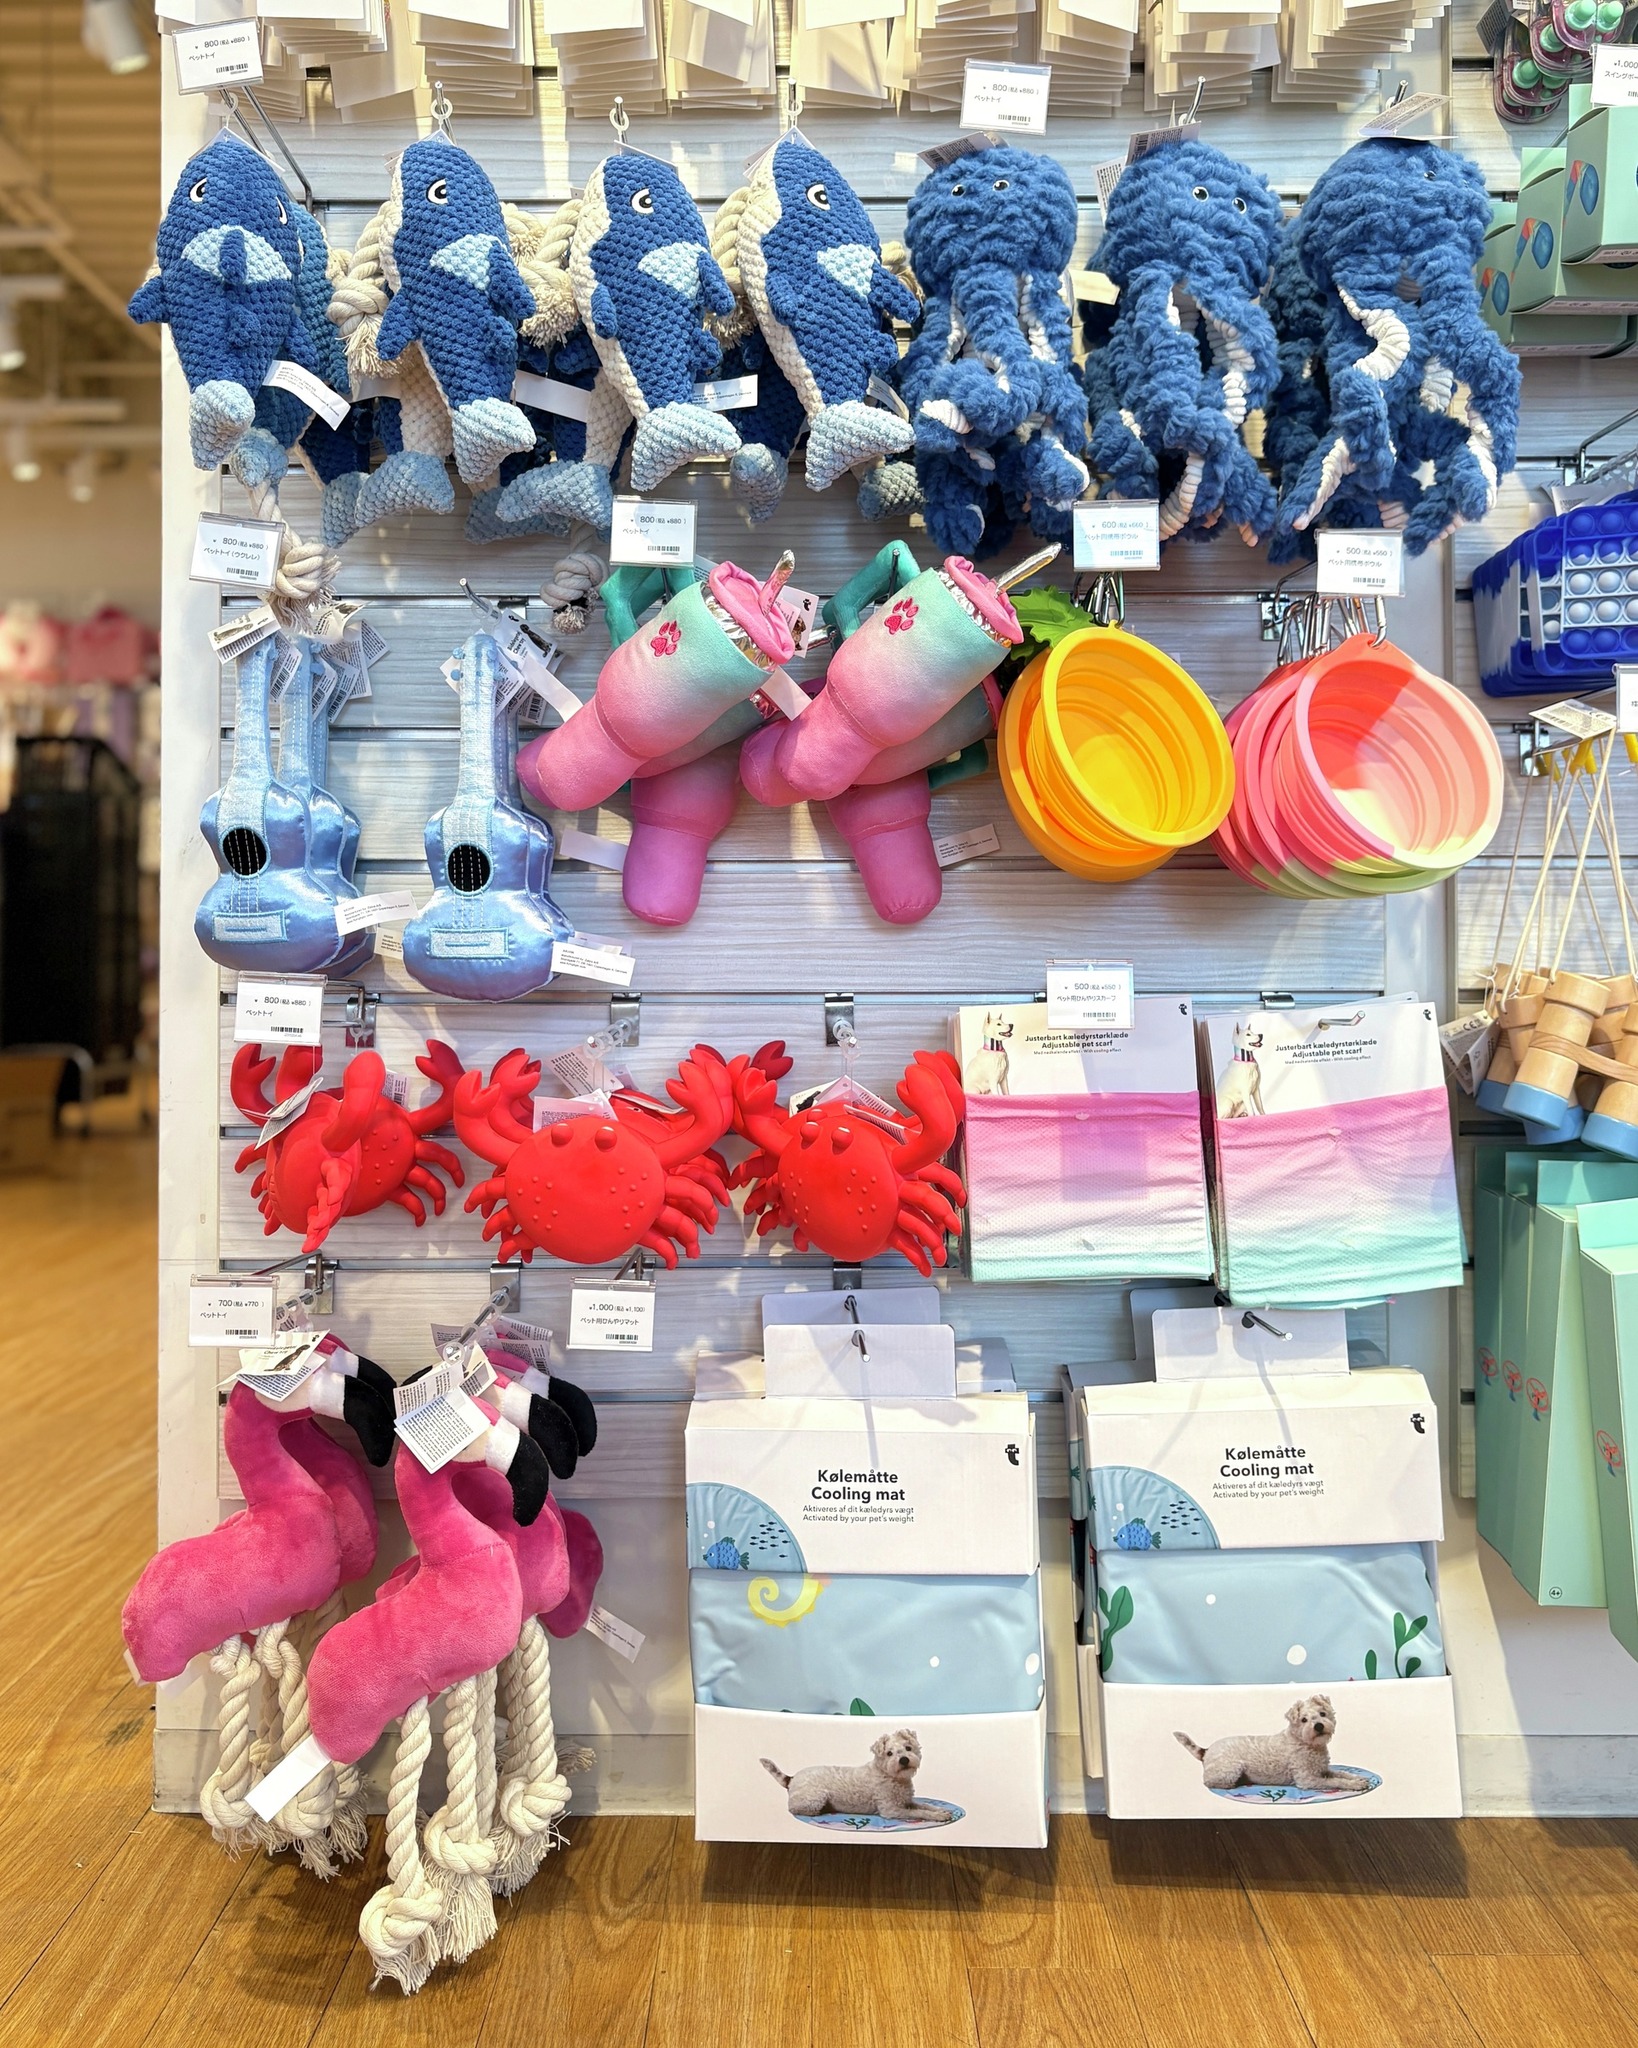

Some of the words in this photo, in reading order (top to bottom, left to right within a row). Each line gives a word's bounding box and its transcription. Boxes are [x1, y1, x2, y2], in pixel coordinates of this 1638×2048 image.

[189, 52, 215, 61] ペットトイ
[1063, 1032, 1128, 1040] kæledyrstørklæde
[1313, 1039, 1377, 1048] kæledyrstørklæde
[1292, 1050, 1330, 1058] Adjustable
[1225, 1445, 1306, 1460] Kølemåtte
[818, 1469, 898, 1483] Kølemåtte
[1220, 1464, 1280, 1479] Cooling
[1285, 1463, 1314, 1475] mat
[1269, 1480, 1302, 1491] kæledyrs
[1304, 1480, 1323, 1489] vægt
[812, 1486, 871, 1504] Cooling
[876, 1489, 905, 1500] mat
[1250, 1490, 1259, 1499] by
[1299, 1488, 1324, 1497] weight
[860, 1506, 893, 1516] kæledyrs
[895, 1507, 914, 1515] vægt
[840, 1514, 849, 1523] by
[888, 1515, 914, 1524] weight
